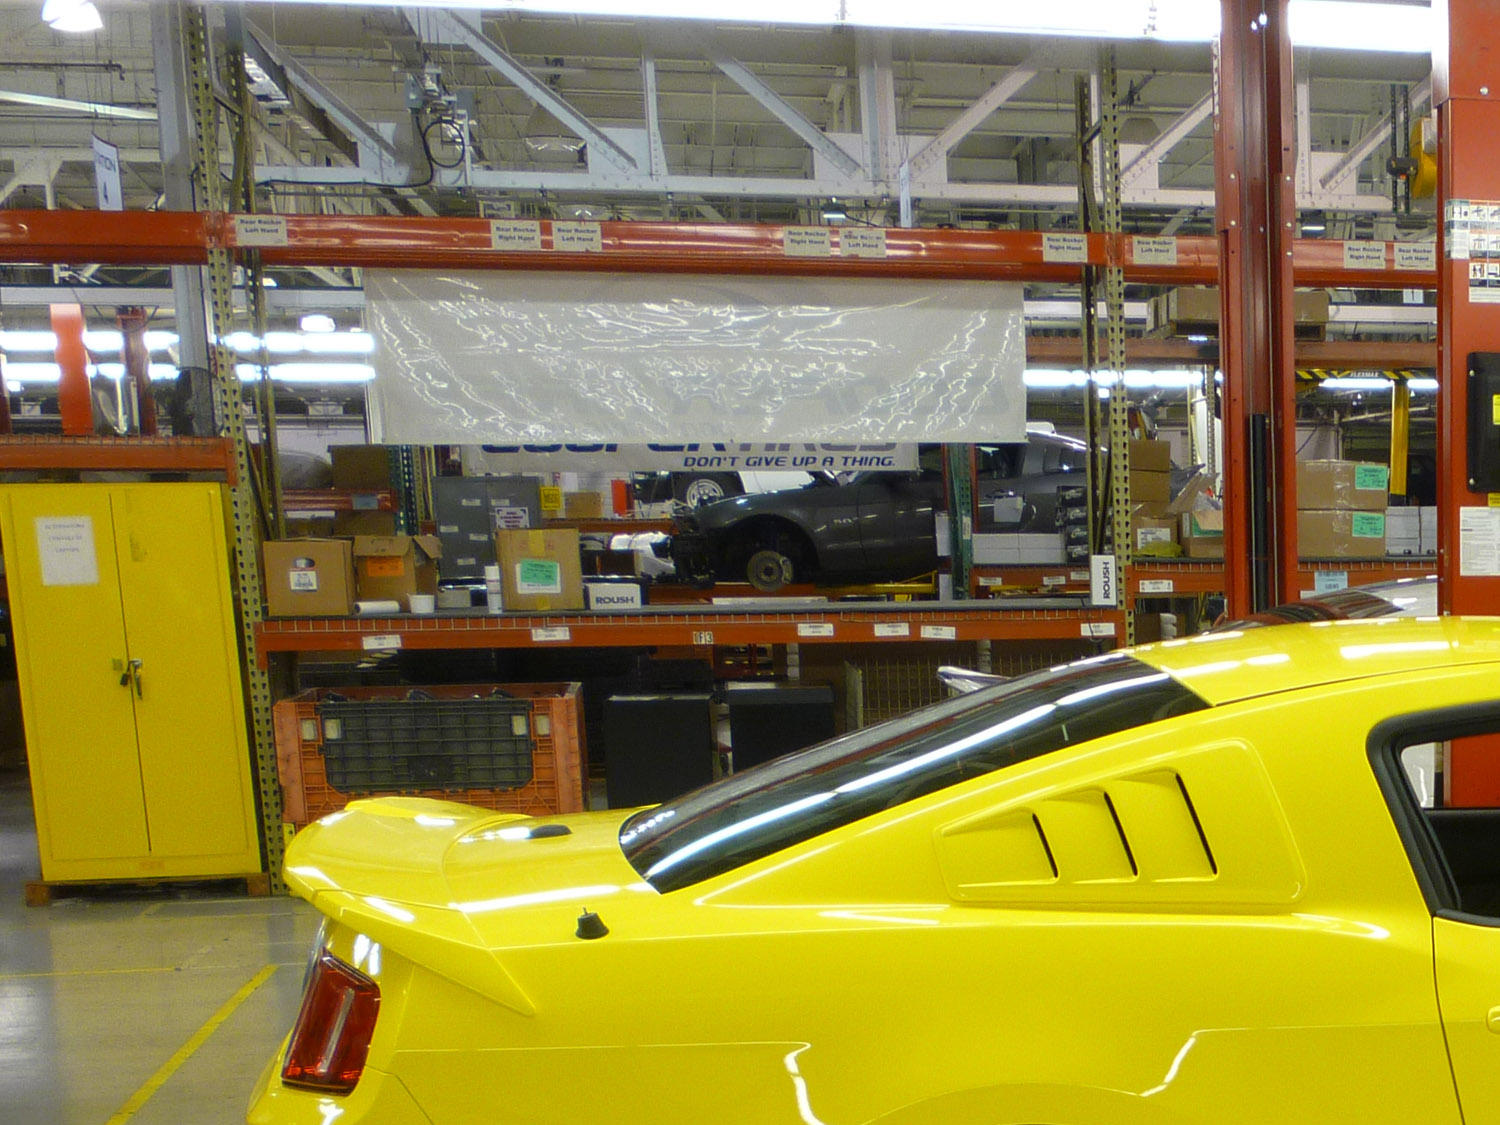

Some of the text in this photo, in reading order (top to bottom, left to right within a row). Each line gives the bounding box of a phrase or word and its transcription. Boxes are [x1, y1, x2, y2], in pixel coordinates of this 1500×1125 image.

[683, 455, 895, 467] DON'T GIVE UP A THING.
[595, 596, 634, 604] ROUSH
